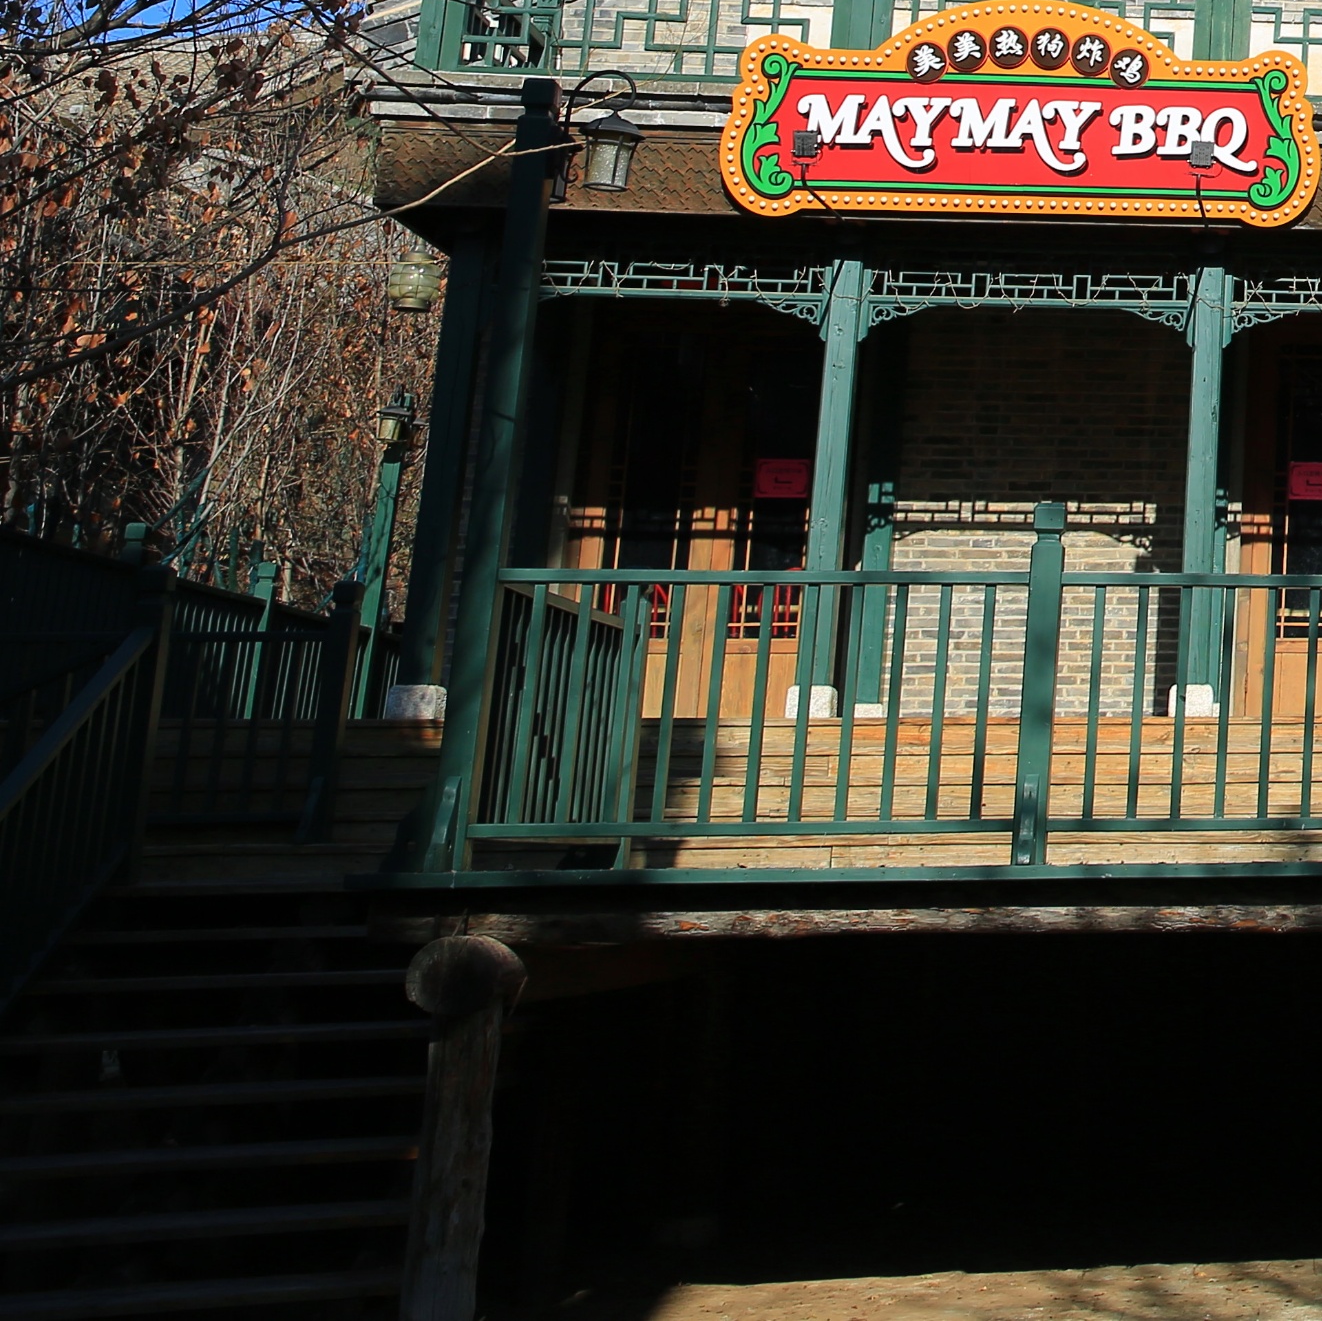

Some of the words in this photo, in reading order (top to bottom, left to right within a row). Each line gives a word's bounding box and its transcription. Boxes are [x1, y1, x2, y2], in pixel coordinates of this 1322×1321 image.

[911, 29, 1143, 84] 美美热狗炸鸡
[796, 93, 1103, 173] MAYMAY
[1108, 104, 1259, 173] BBQ
